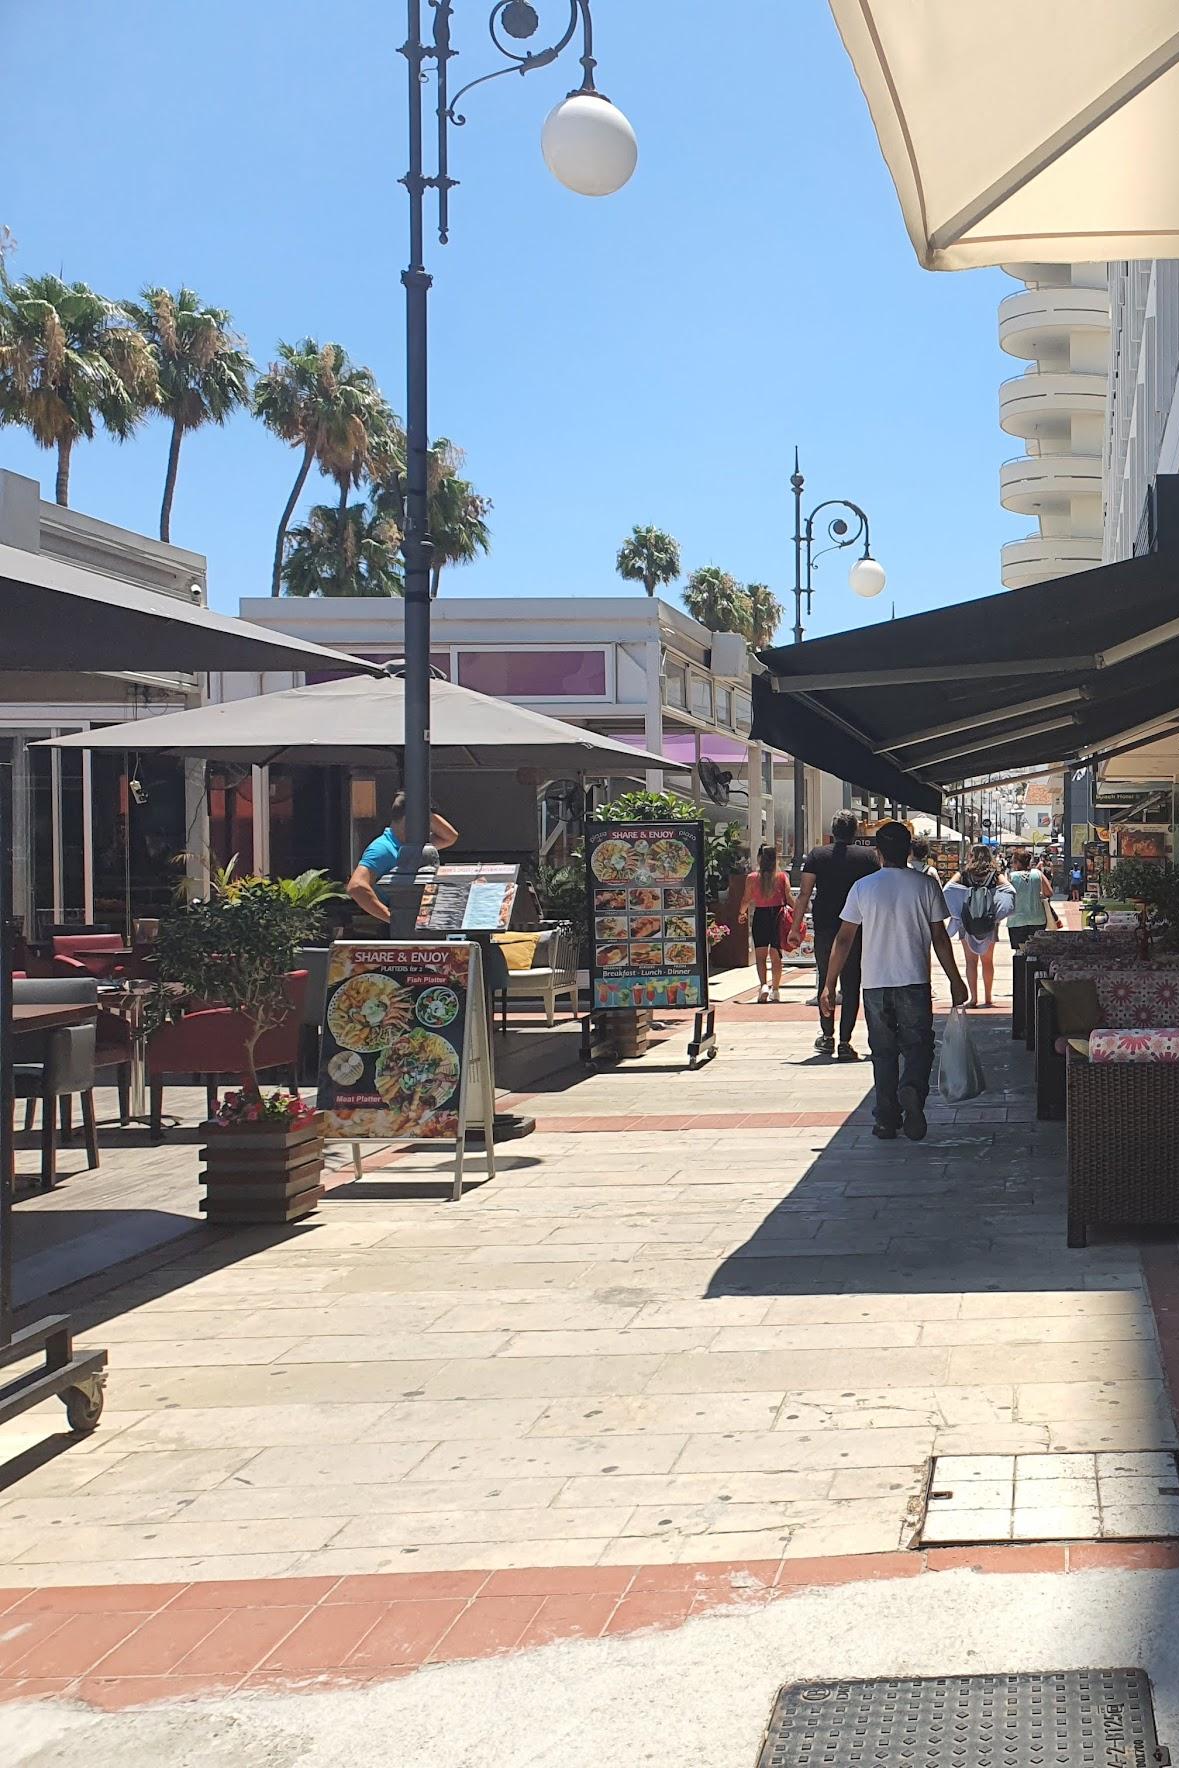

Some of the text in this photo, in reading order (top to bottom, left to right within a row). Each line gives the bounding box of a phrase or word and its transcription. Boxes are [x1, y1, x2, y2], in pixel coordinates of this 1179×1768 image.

[611, 830, 674, 839] SHARE & ENJOY
[354, 951, 449, 963] SHARE & ENJOY
[602, 967, 692, 979] Breakfast Lunch Dinner
